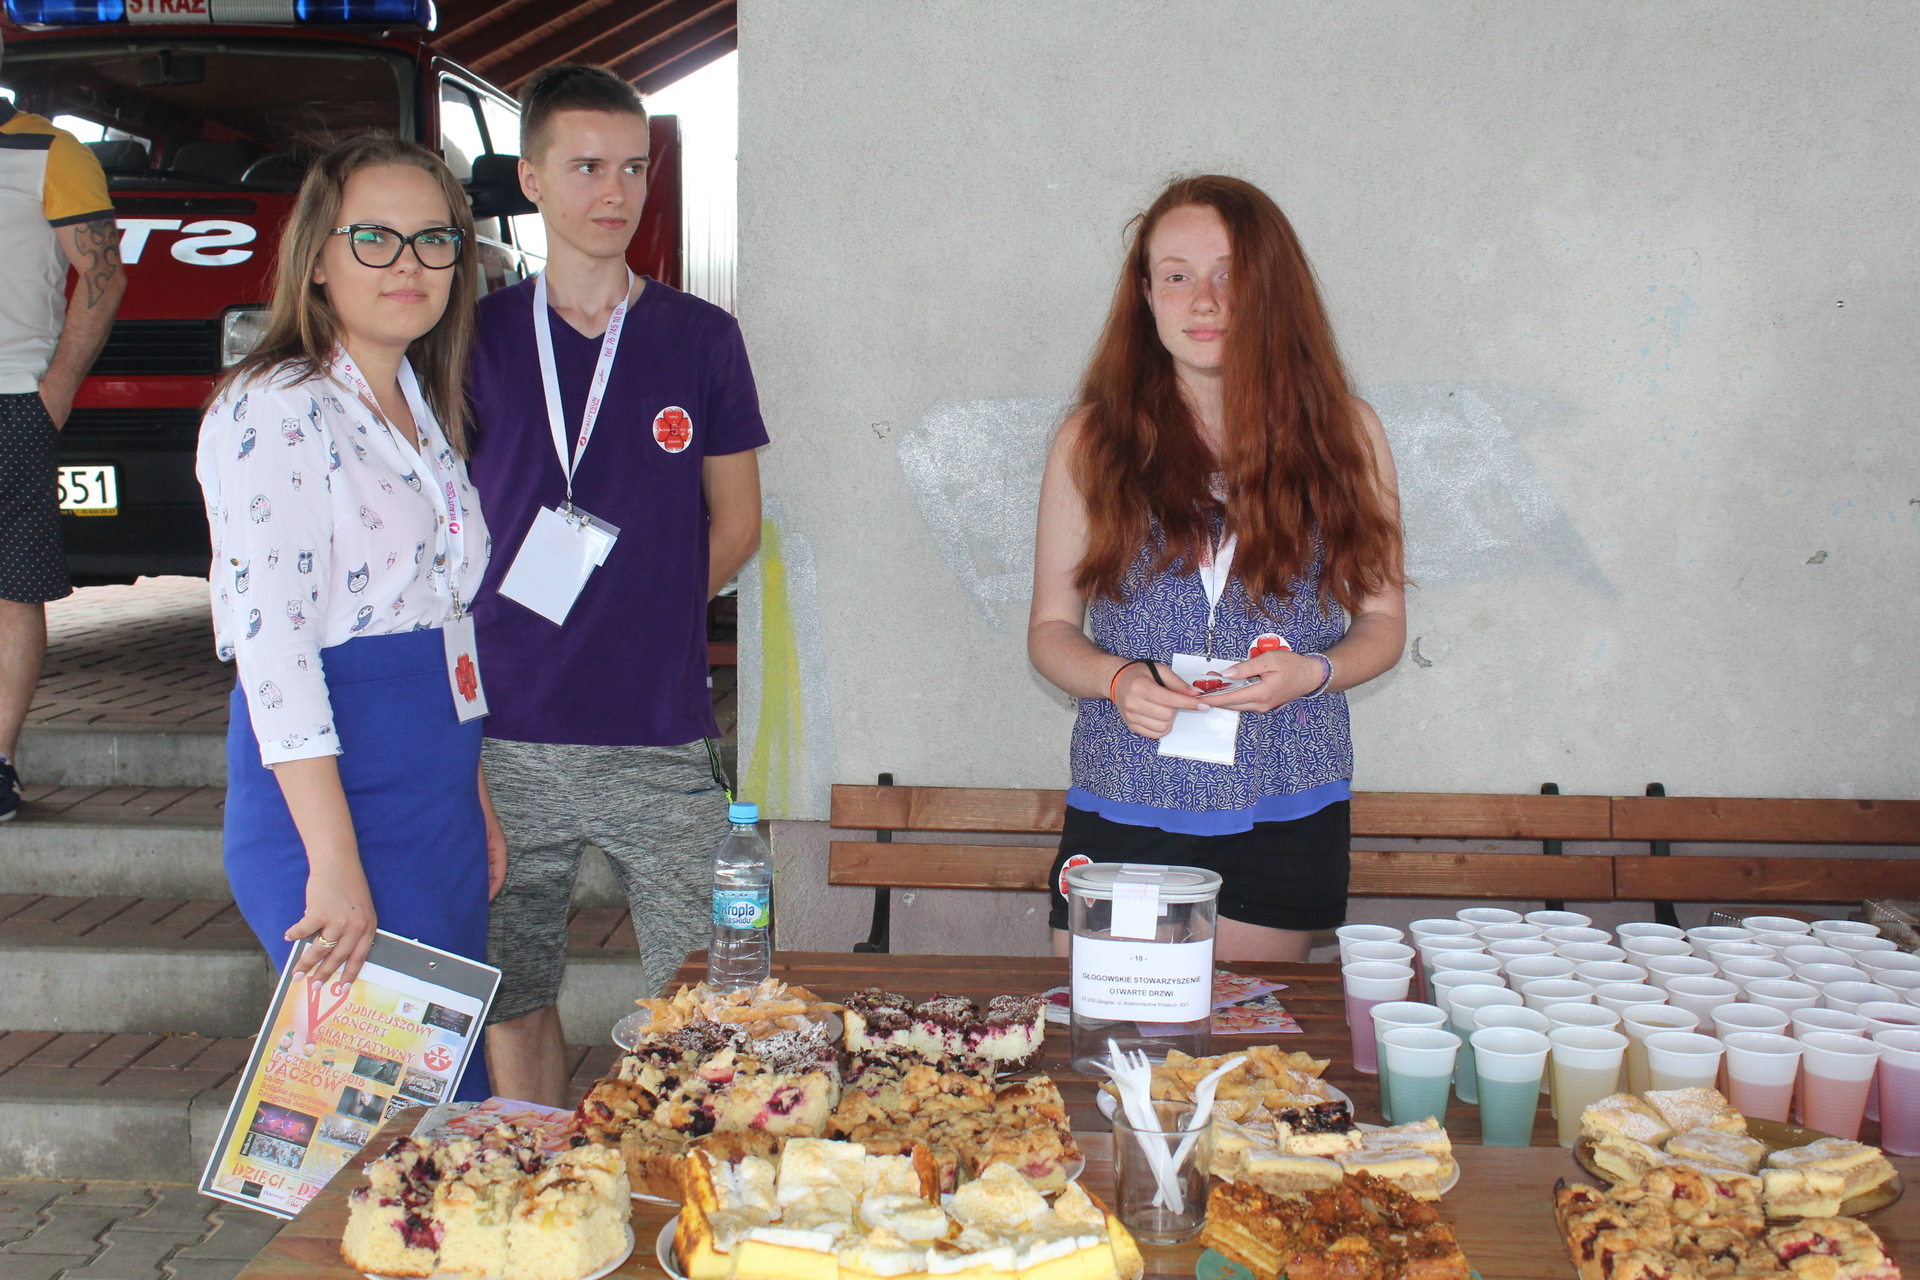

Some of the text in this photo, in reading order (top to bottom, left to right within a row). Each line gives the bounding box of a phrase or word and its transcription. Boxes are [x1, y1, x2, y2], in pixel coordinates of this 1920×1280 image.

[721, 901, 755, 918] Kropla
[1082, 972, 1201, 985] GŁOGOWSKIE STOWARZYSZENIE
[1109, 988, 1147, 996] OTWARTE
[332, 1012, 389, 1038] KONCERT
[344, 1001, 436, 1038] JUBILEUSZOWY
[318, 1025, 416, 1063] CHARYTATYWNY
[270, 1049, 366, 1088] 16 CZERWIEC 2018
[231, 1162, 287, 1189] DZIECI
